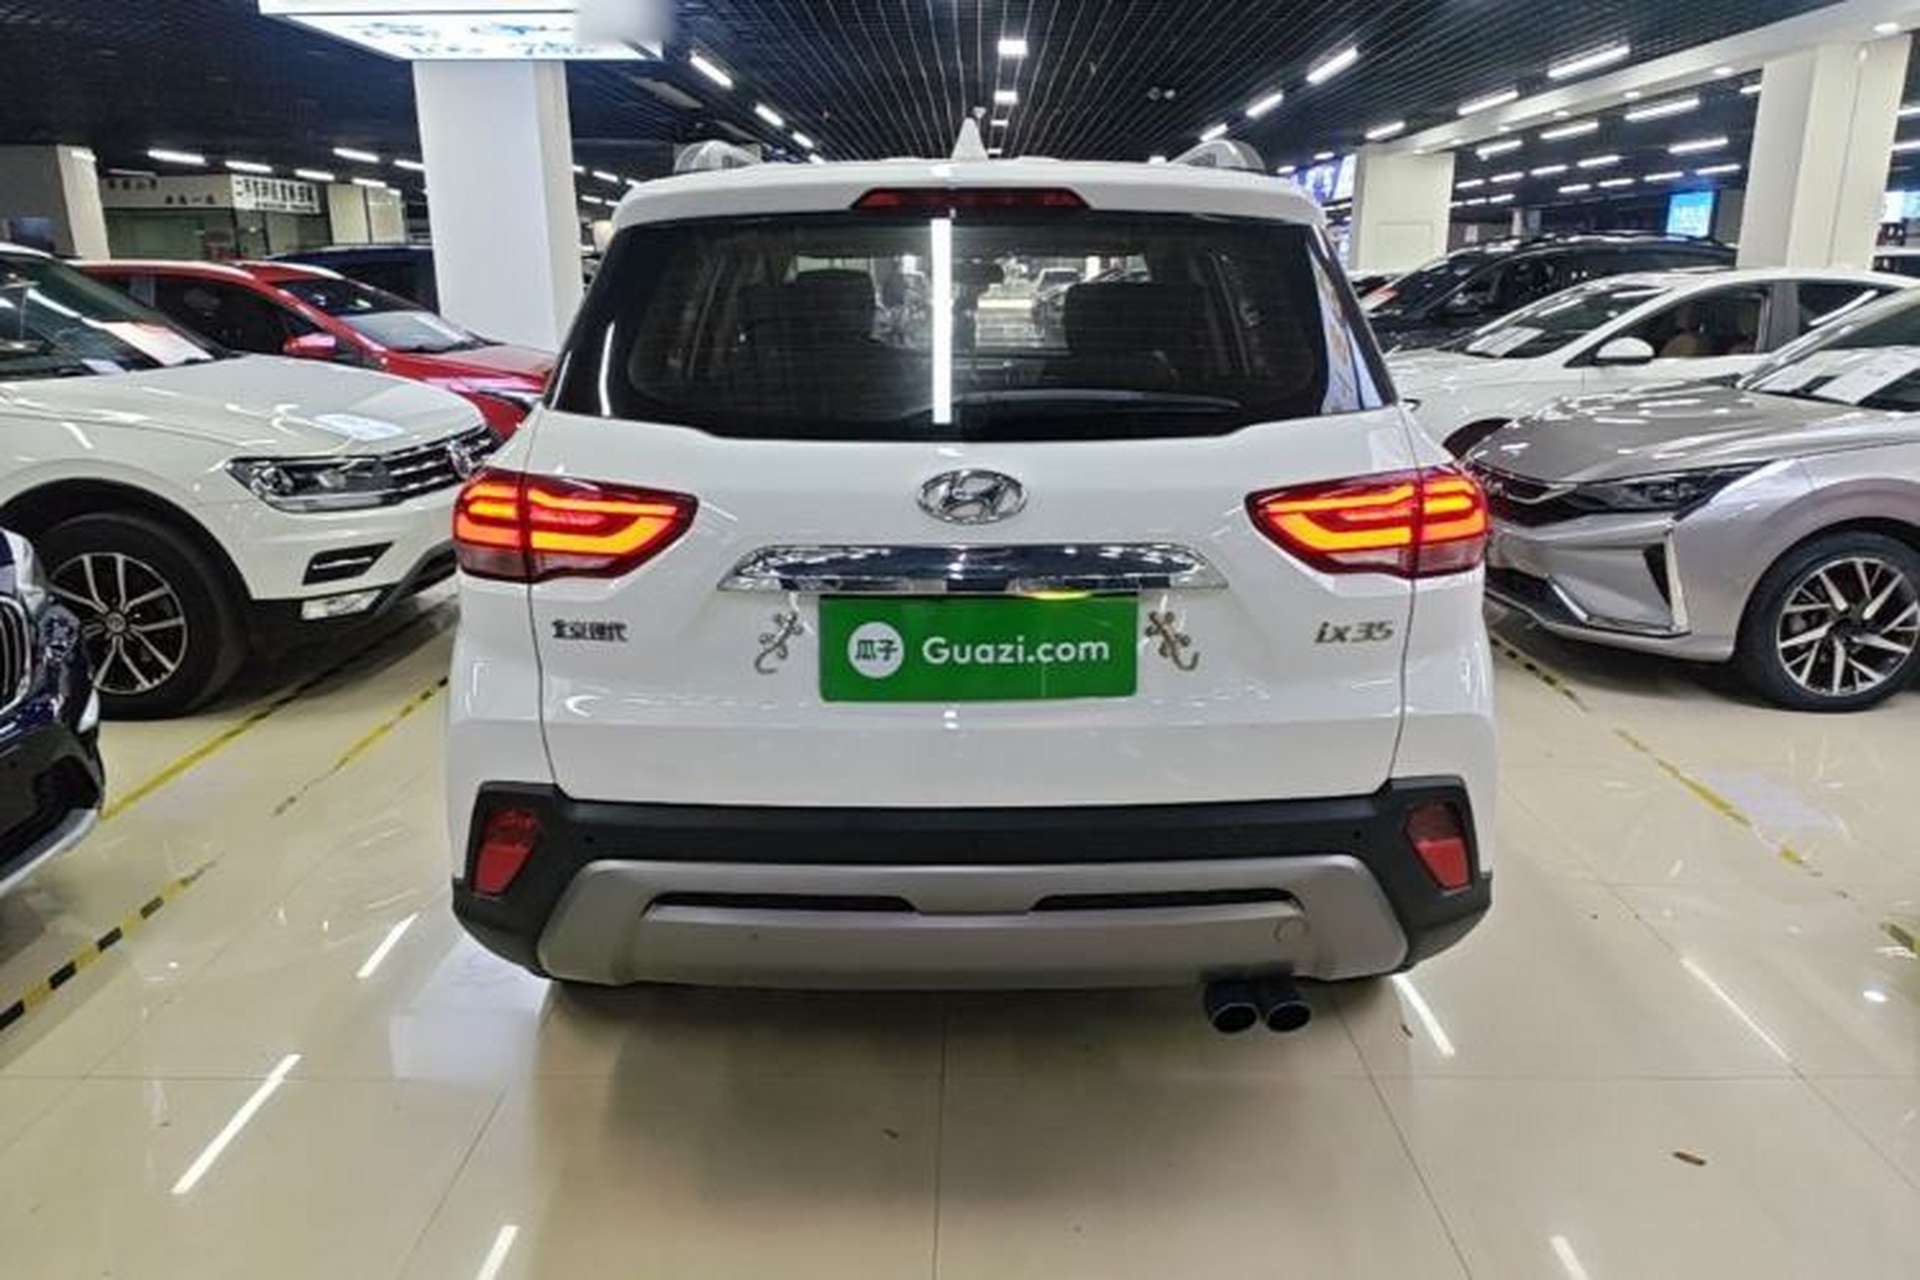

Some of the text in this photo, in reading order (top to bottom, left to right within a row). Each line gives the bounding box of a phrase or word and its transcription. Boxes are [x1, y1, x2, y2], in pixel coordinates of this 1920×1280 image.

[1314, 621, 1393, 643] ix35
[855, 638, 898, 661] 瓜子
[921, 635, 1110, 665] Guazi.com
